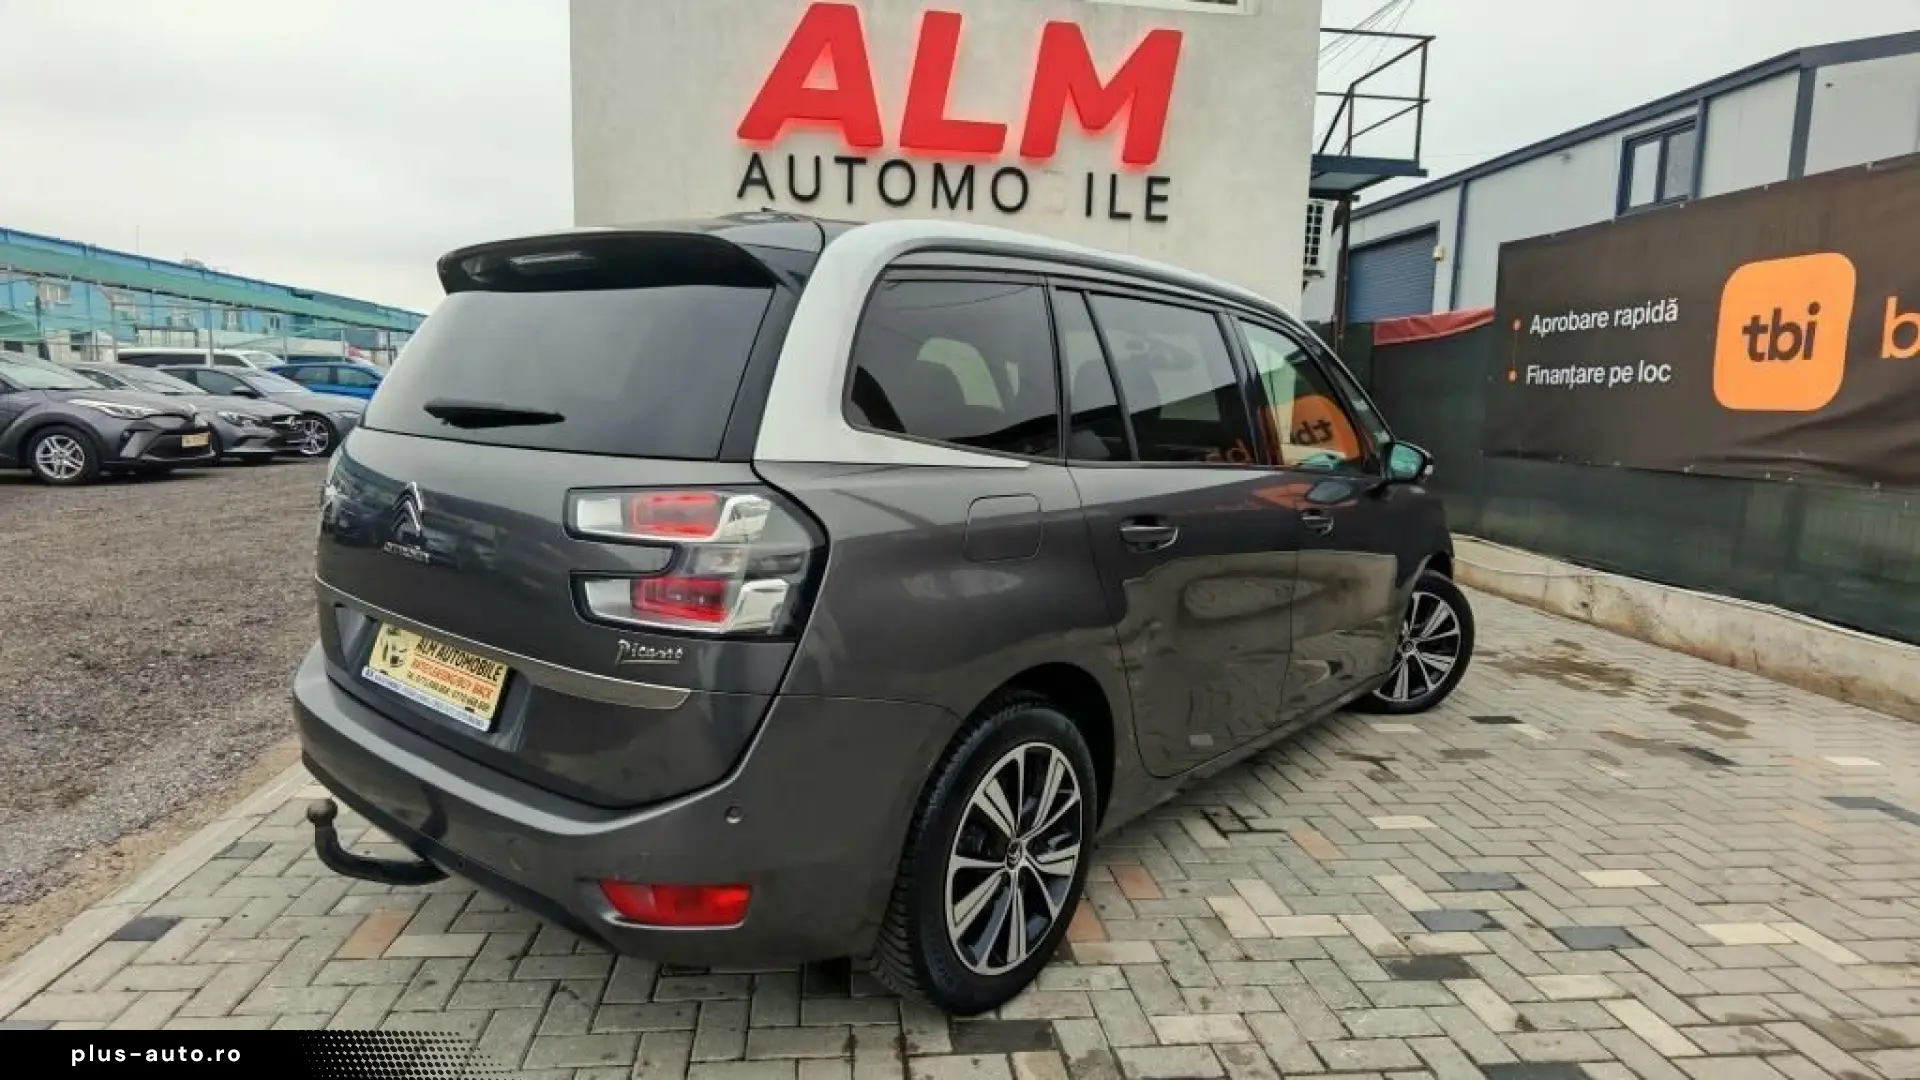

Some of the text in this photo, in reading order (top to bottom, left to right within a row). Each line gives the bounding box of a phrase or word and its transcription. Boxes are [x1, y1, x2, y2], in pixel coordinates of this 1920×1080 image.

[736, 1, 1183, 164] ALM
[737, 153, 1171, 223] AUTOMOILE
[1529, 298, 1679, 338] Aprobare rapidă
[1742, 301, 1821, 362] tbi
[1526, 360, 1672, 389] Finanțare pe loc
[435, 642, 504, 682] AUTOMOBILE
